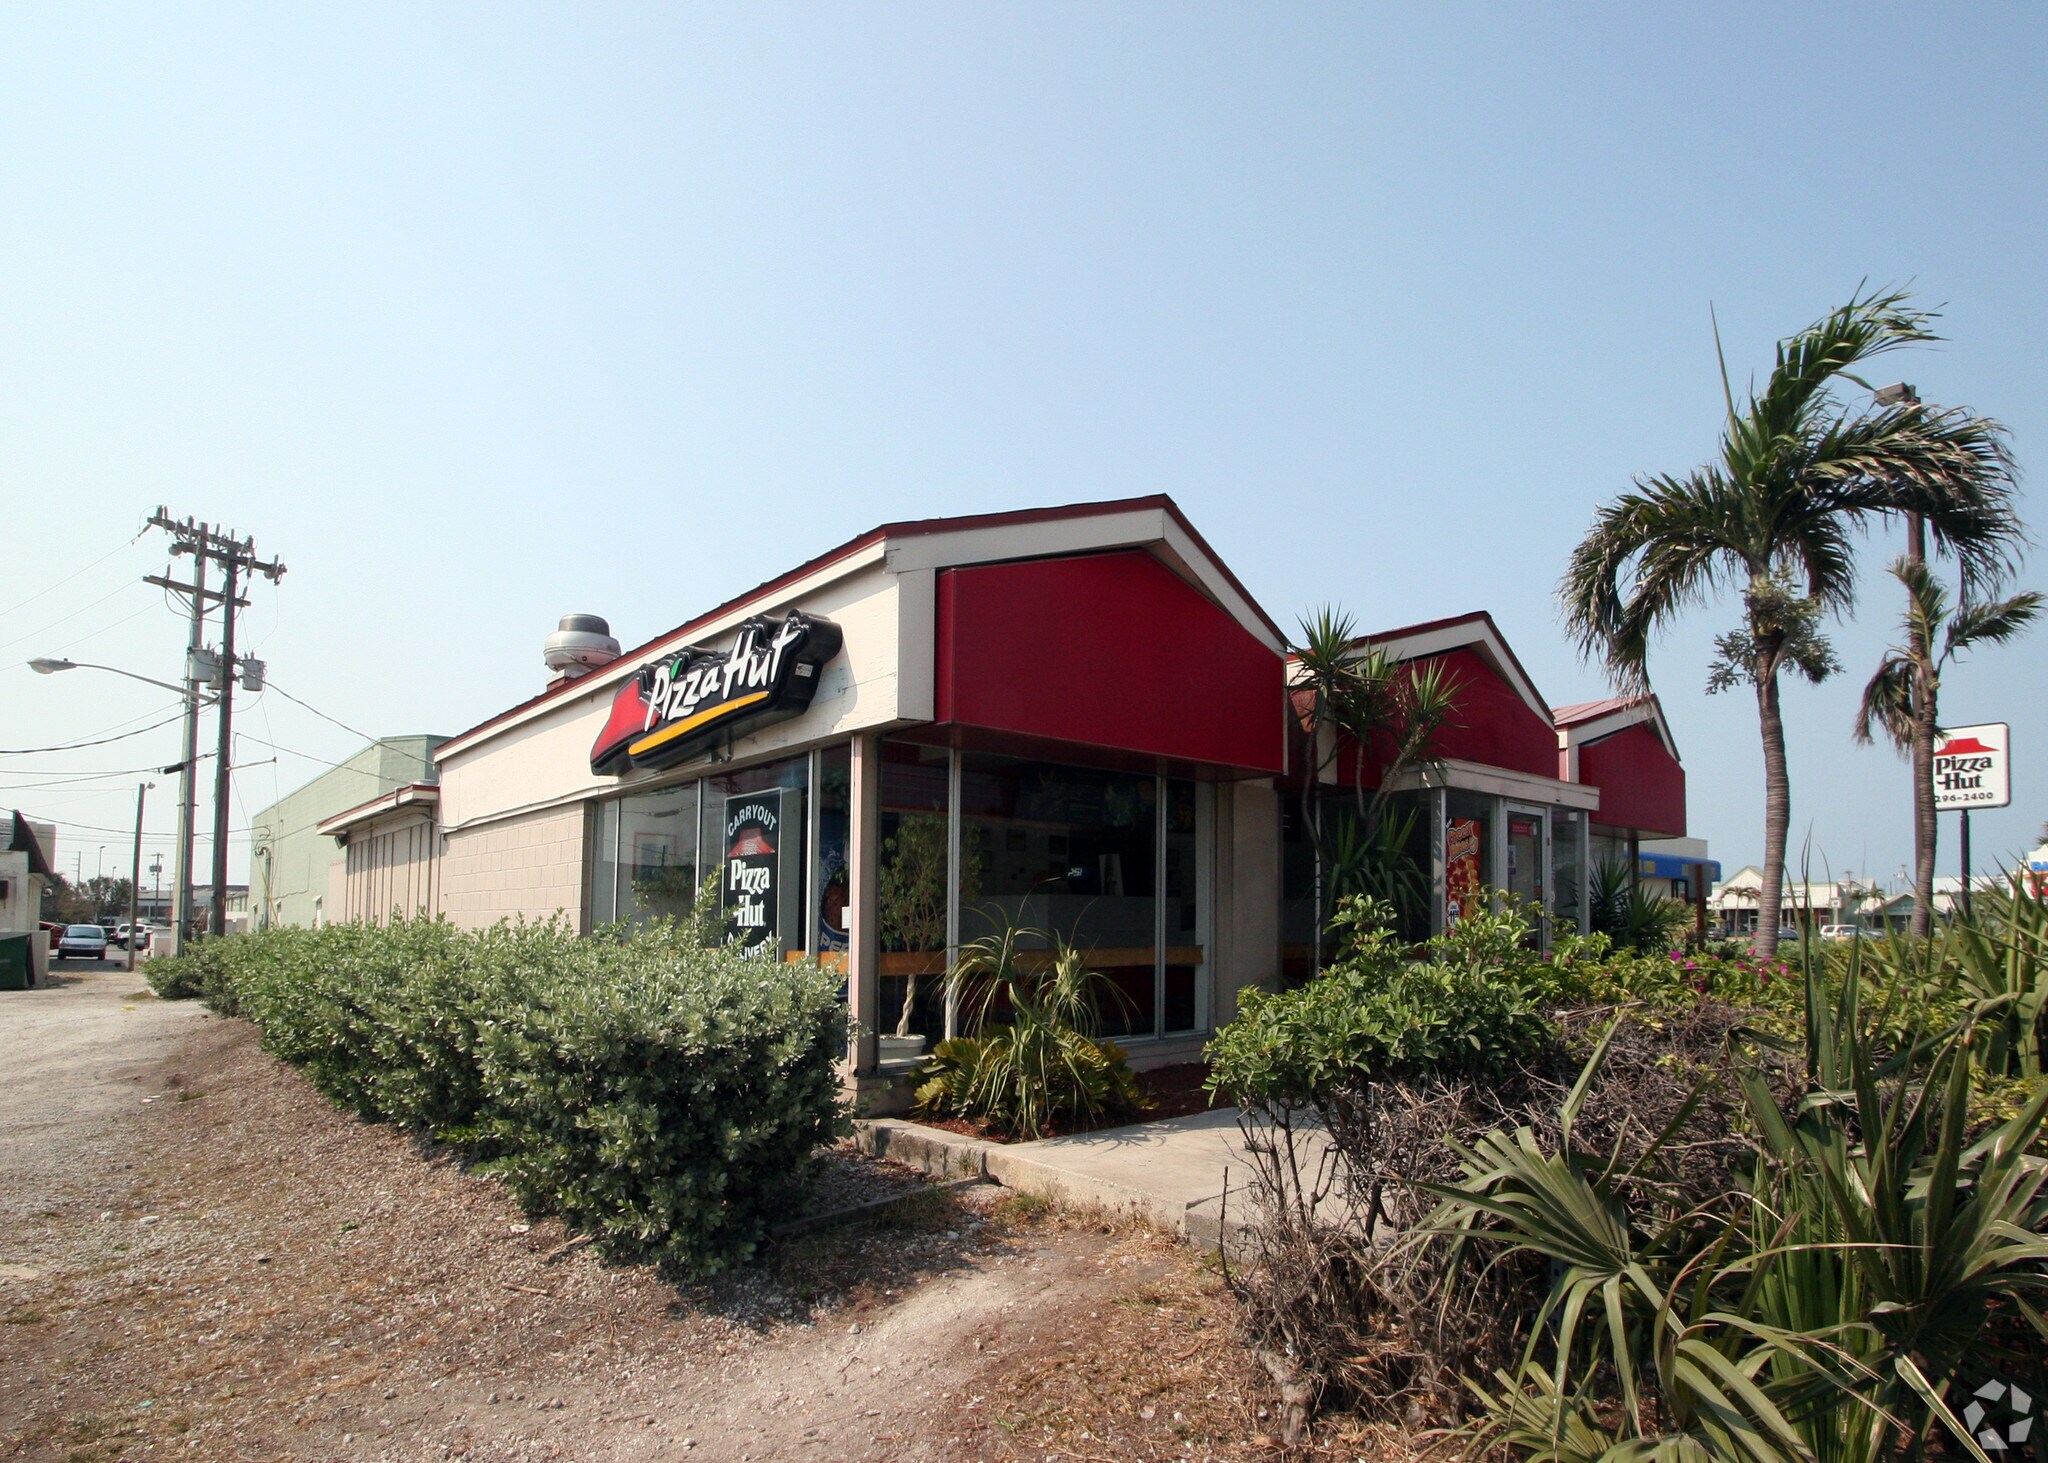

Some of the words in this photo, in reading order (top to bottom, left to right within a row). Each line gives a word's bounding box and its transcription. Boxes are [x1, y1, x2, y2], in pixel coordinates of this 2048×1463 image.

[644, 658, 721, 732] Pizza
[723, 623, 801, 699] Hut
[1935, 756, 1992, 775] Pizza
[1936, 773, 1982, 790] Hut
[728, 804, 777, 837] CARRYOUT
[730, 859, 770, 895] Pizza
[732, 895, 765, 927] Hut
[727, 930, 774, 961] DIVERY
